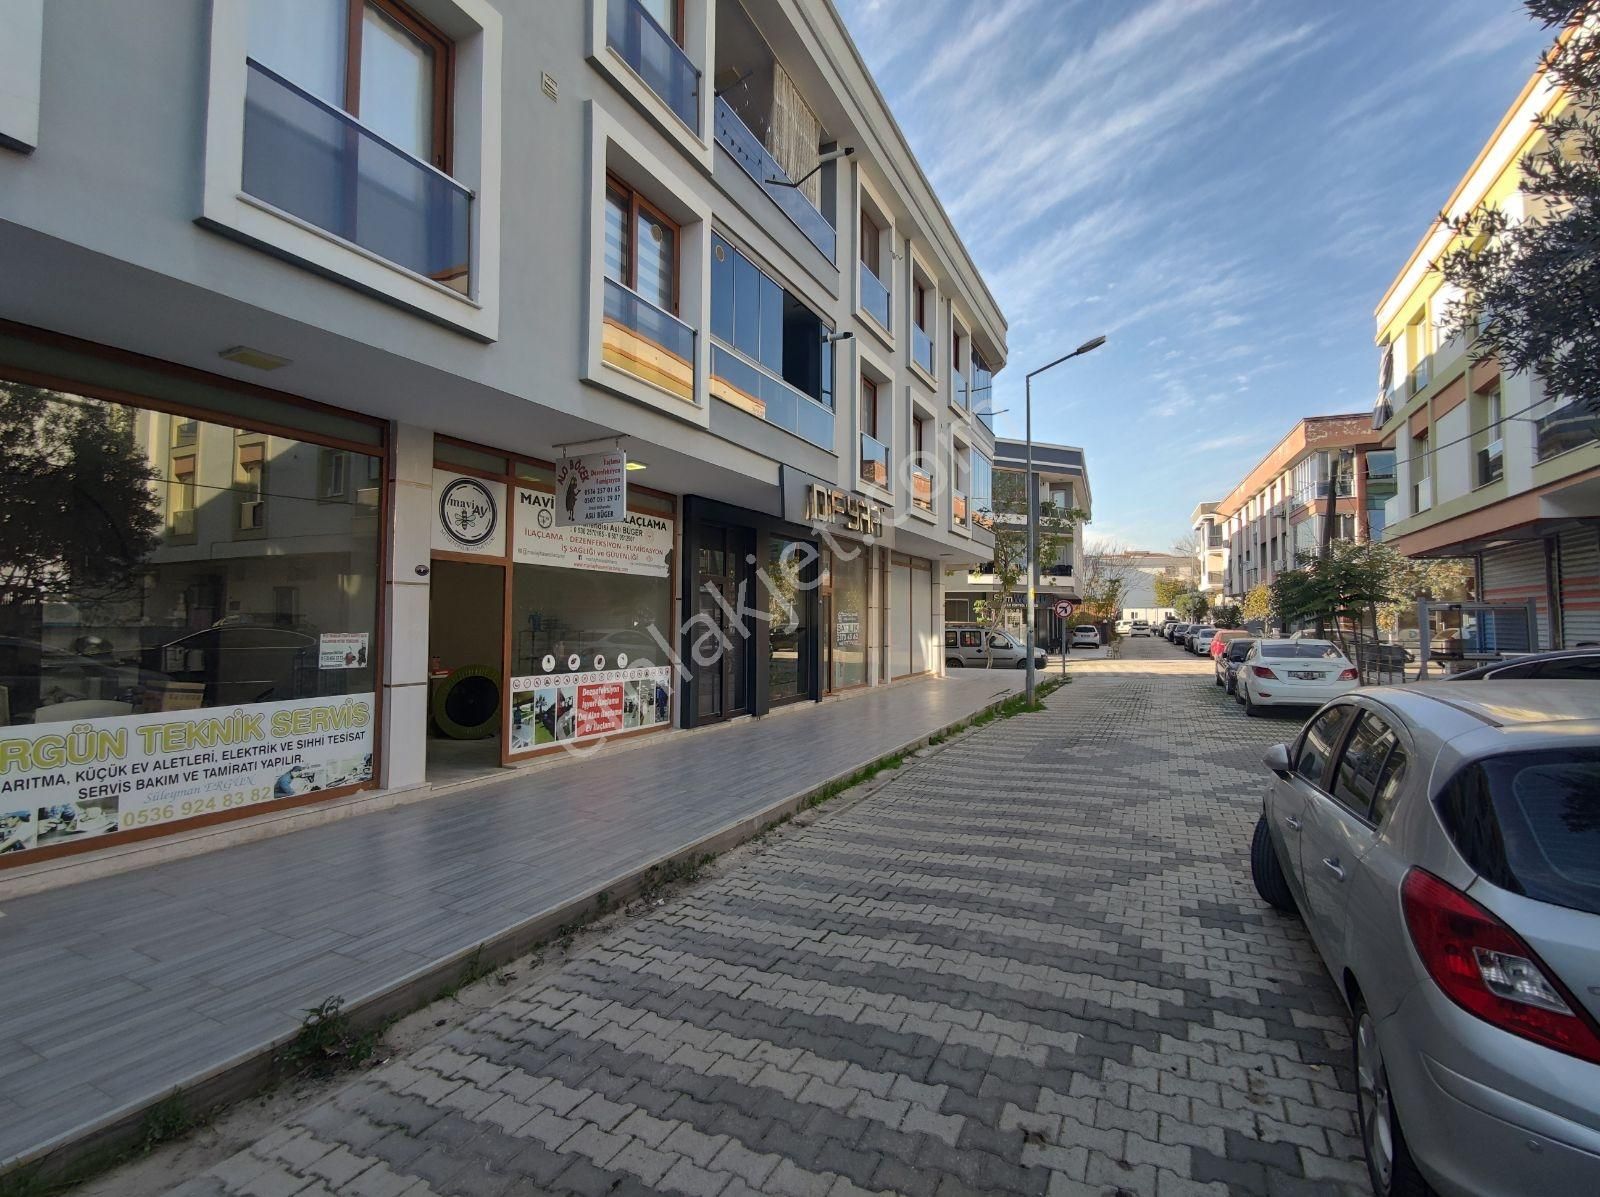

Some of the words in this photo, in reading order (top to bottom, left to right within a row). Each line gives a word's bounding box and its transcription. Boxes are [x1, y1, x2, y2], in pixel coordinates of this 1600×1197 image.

[520, 492, 555, 510] MAVİ
[623, 513, 668, 532] LAÇLAMA
[136, 708, 265, 756] TEKNİK
[270, 698, 371, 738] SERVİS
[1, 774, 70, 794] ARITMA,
[75, 765, 128, 783] KÜÇÜK
[131, 761, 150, 775] EV
[222, 742, 278, 761] ELEKTRİK
[280, 741, 294, 752] VE
[296, 736, 325, 750] SIHHİ
[327, 731, 366, 744] TESİSAT
[78, 779, 131, 800] SERVİS
[136, 773, 178, 790] BAKIM
[182, 771, 199, 783] VE
[203, 761, 258, 778] TAMİRATI
[261, 754, 305, 770] YAPILIR.
[122, 806, 174, 828] 0536
[181, 798, 217, 816] 924
[222, 791, 245, 808] 83
[250, 786, 272, 802] 82
[144, 786, 201, 806] Süleyman
